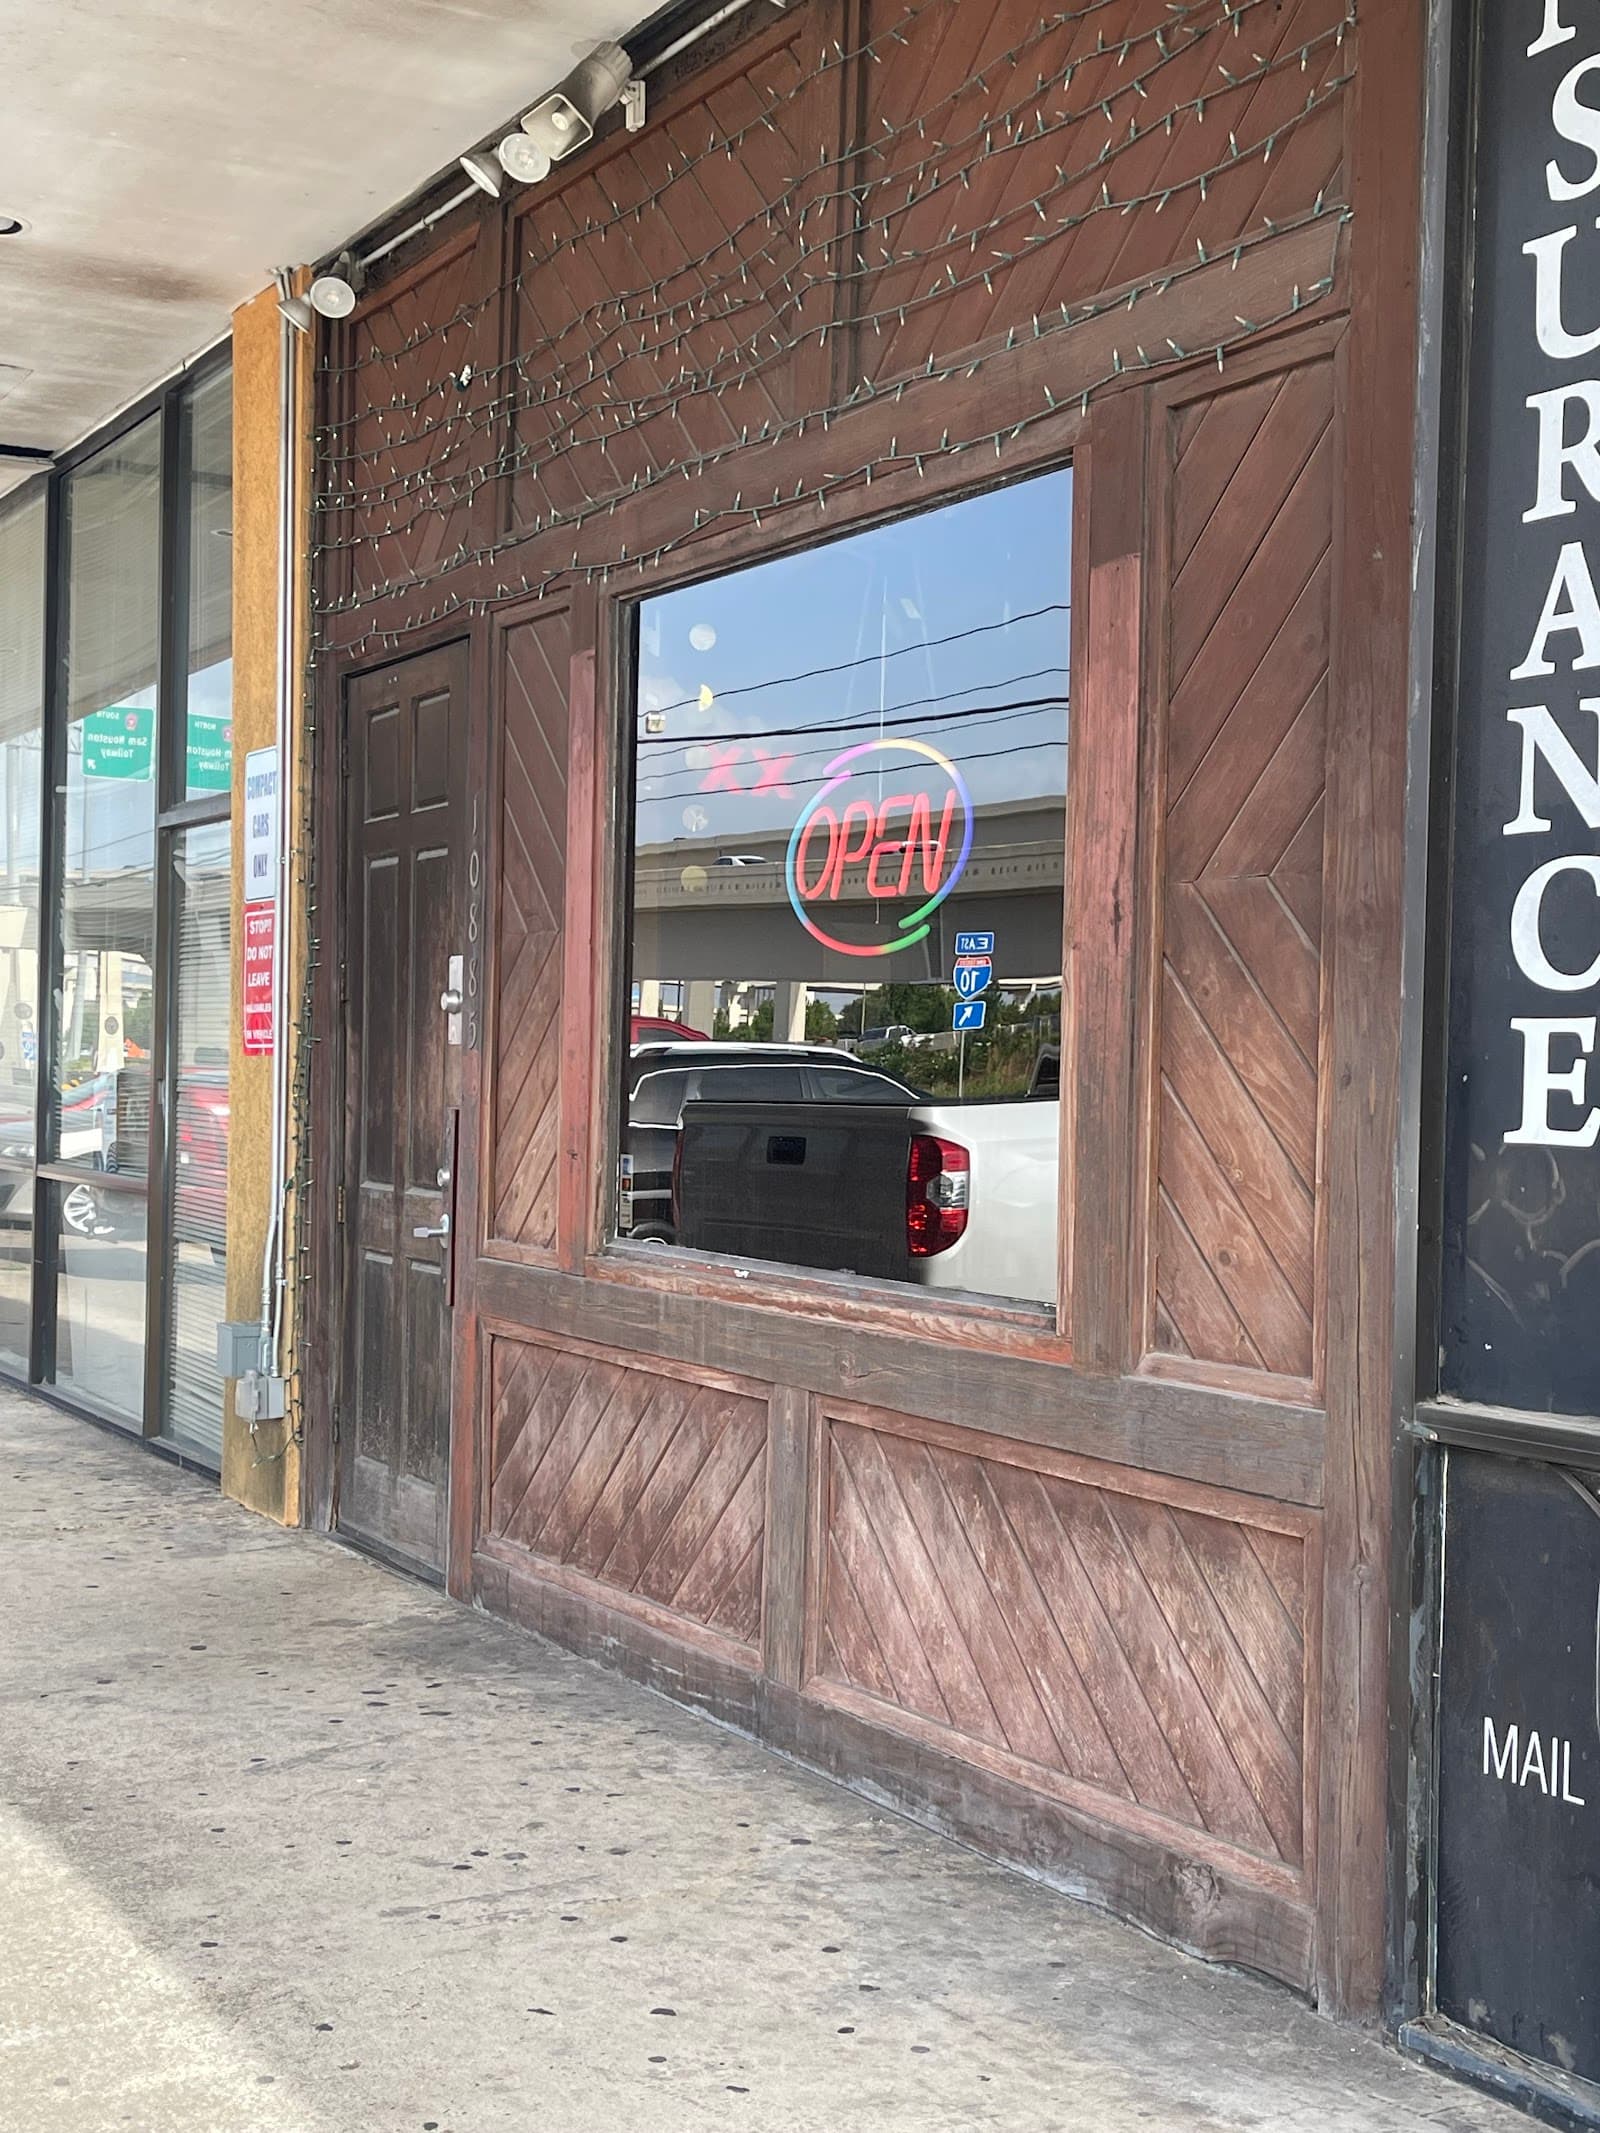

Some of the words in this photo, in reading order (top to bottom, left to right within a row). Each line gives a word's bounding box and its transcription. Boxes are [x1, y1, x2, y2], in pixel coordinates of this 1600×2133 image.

[1502, 0, 1600, 1147] SURANCE
[247, 771, 277, 800] COMPACT
[253, 813, 269, 838] CARS
[797, 789, 956, 900] OPEN
[253, 852, 268, 878] ONLY
[246, 946, 258, 961] DO
[258, 944, 273, 960] NOT
[248, 972, 270, 987] LEAVE
[1483, 1716, 1585, 1806] MAIL
